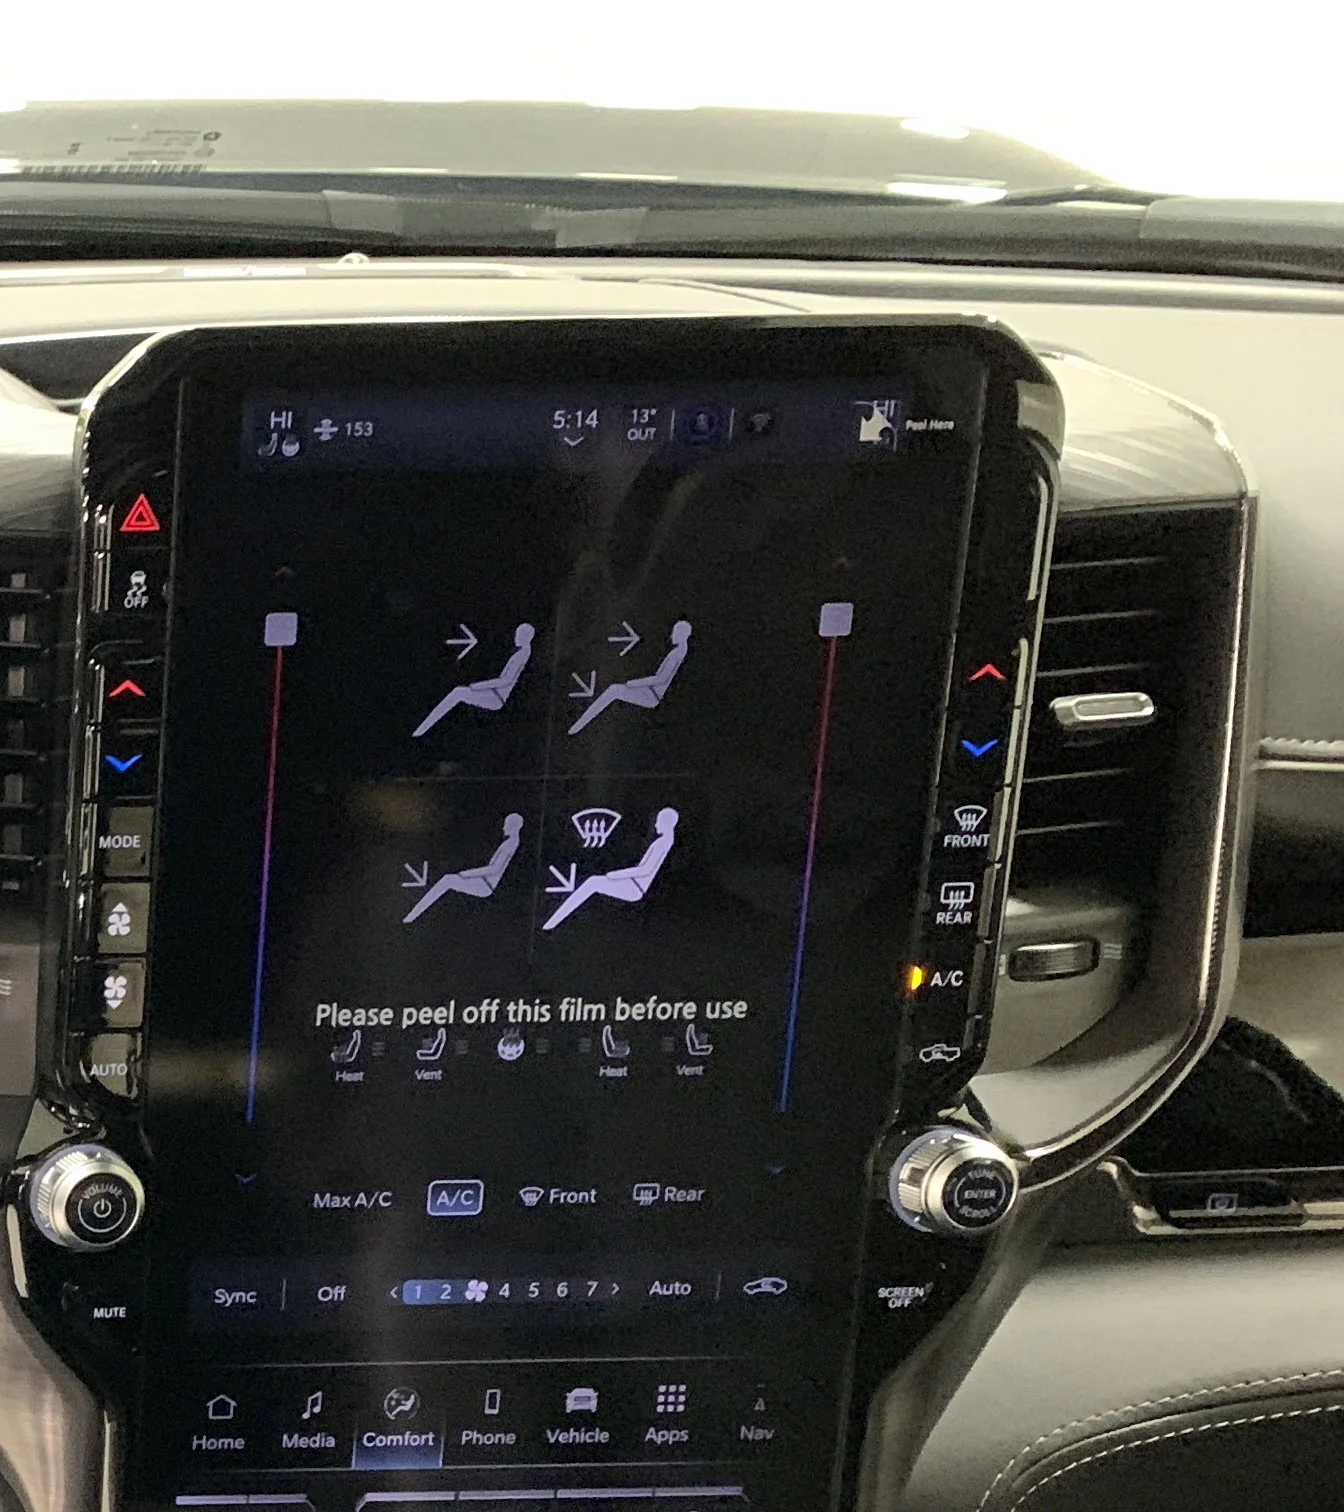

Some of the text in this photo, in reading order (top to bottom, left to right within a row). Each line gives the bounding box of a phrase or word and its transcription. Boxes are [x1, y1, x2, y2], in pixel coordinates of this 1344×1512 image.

[270, 410, 292, 429] HI
[553, 409, 599, 429] 5:14
[905, 419, 928, 431] Peel
[345, 421, 373, 437] 153
[627, 427, 657, 441] OUT
[98, 835, 141, 849] MODE
[943, 834, 990, 848] FRONT
[936, 911, 973, 924] REAR
[930, 970, 964, 987] A/C
[315, 995, 749, 1029] Please peel off this film before use
[90, 1063, 128, 1077] AUTO
[335, 1070, 365, 1082] Heat
[415, 1069, 443, 1081] Vent
[599, 1065, 629, 1077] Heat
[676, 1064, 705, 1076] Vent
[81, 1183, 124, 1199] VOLUME
[436, 1189, 474, 1207] A/C
[549, 1188, 597, 1204] Front
[664, 1186, 706, 1202] Rear
[964, 1189, 997, 1198] ENTER
[313, 1191, 392, 1208] Max A/C
[317, 1285, 347, 1301] Off
[415, 1281, 599, 1299] 1 2 4 5 6 7
[649, 1280, 692, 1295] Auto
[878, 1287, 924, 1298] SCREEN
[214, 1288, 258, 1307] Sync
[888, 1298, 912, 1308] OFF
[93, 1306, 126, 1318] MUTE
[282, 1433, 335, 1448] Media
[362, 1431, 434, 1447] Comfort
[461, 1429, 517, 1445] Phone
[546, 1427, 610, 1443] Vehicle
[645, 1427, 689, 1445] Apps
[739, 1425, 775, 1441] Nav
[192, 1435, 246, 1450] Home
